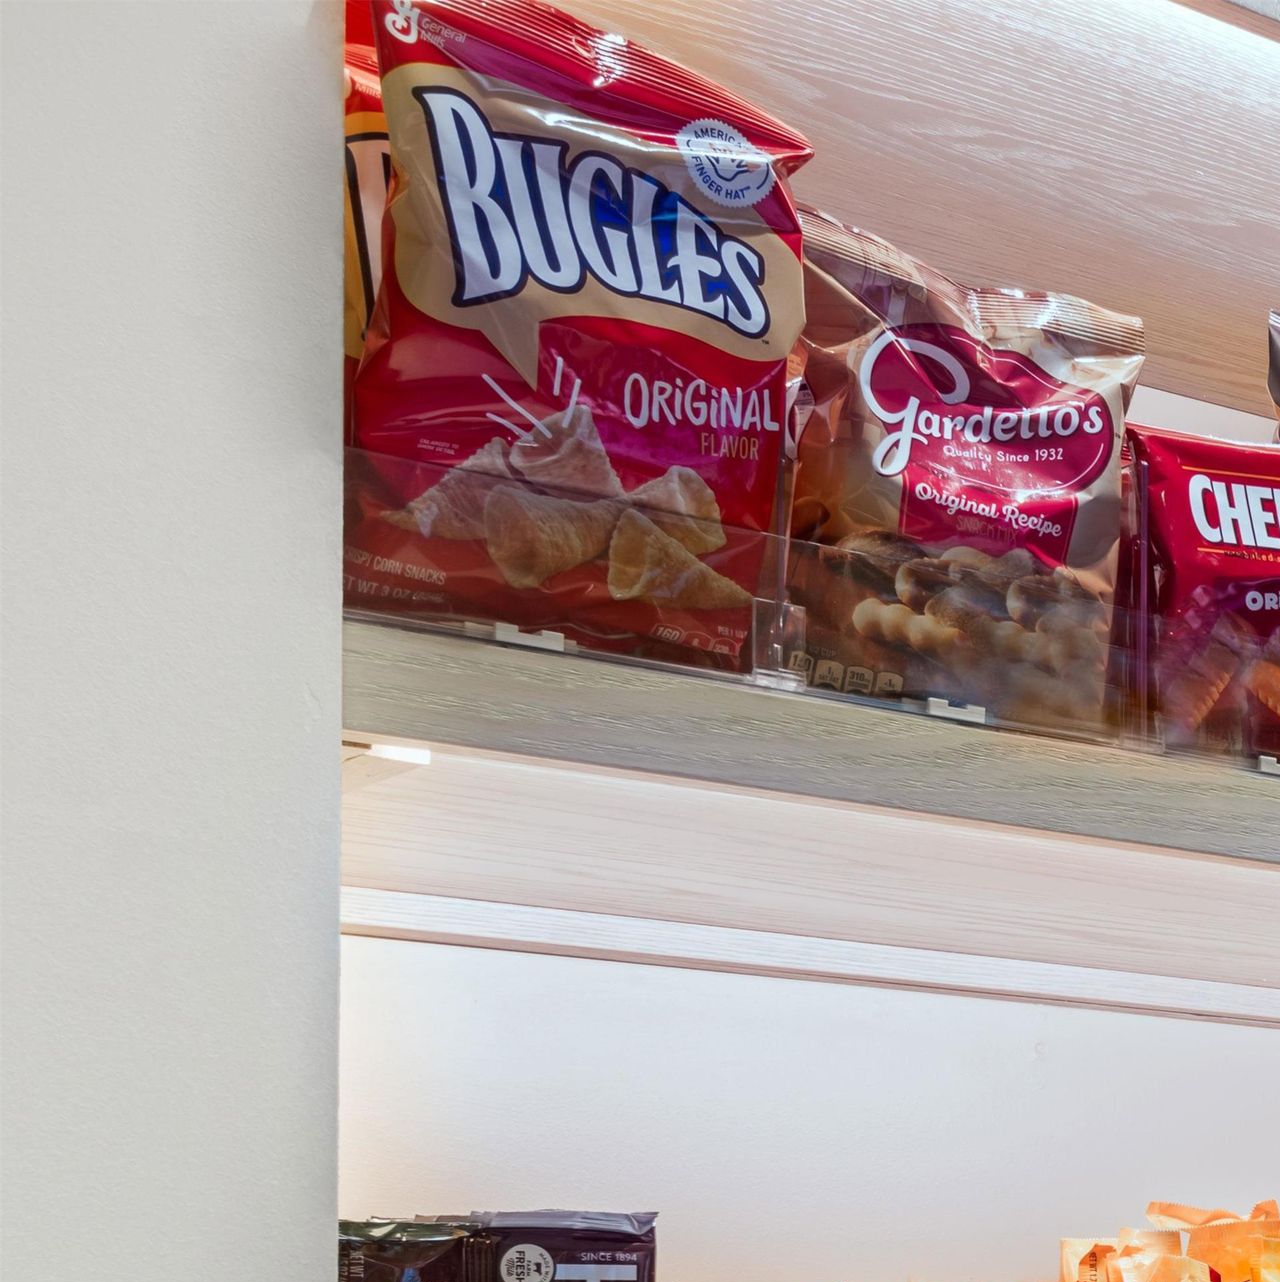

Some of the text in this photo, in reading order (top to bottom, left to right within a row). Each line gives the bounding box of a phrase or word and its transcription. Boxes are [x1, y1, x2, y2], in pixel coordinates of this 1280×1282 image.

[421, 18, 466, 44] General
[691, 155, 751, 201] FINGER HAT
[413, 86, 772, 340] BUGLES
[859, 333, 1105, 477] Gardetto's
[700, 424, 760, 461] FLAVOR
[942, 444, 1065, 463] Quality Since 1932
[914, 481, 1063, 537] Original Recipe
